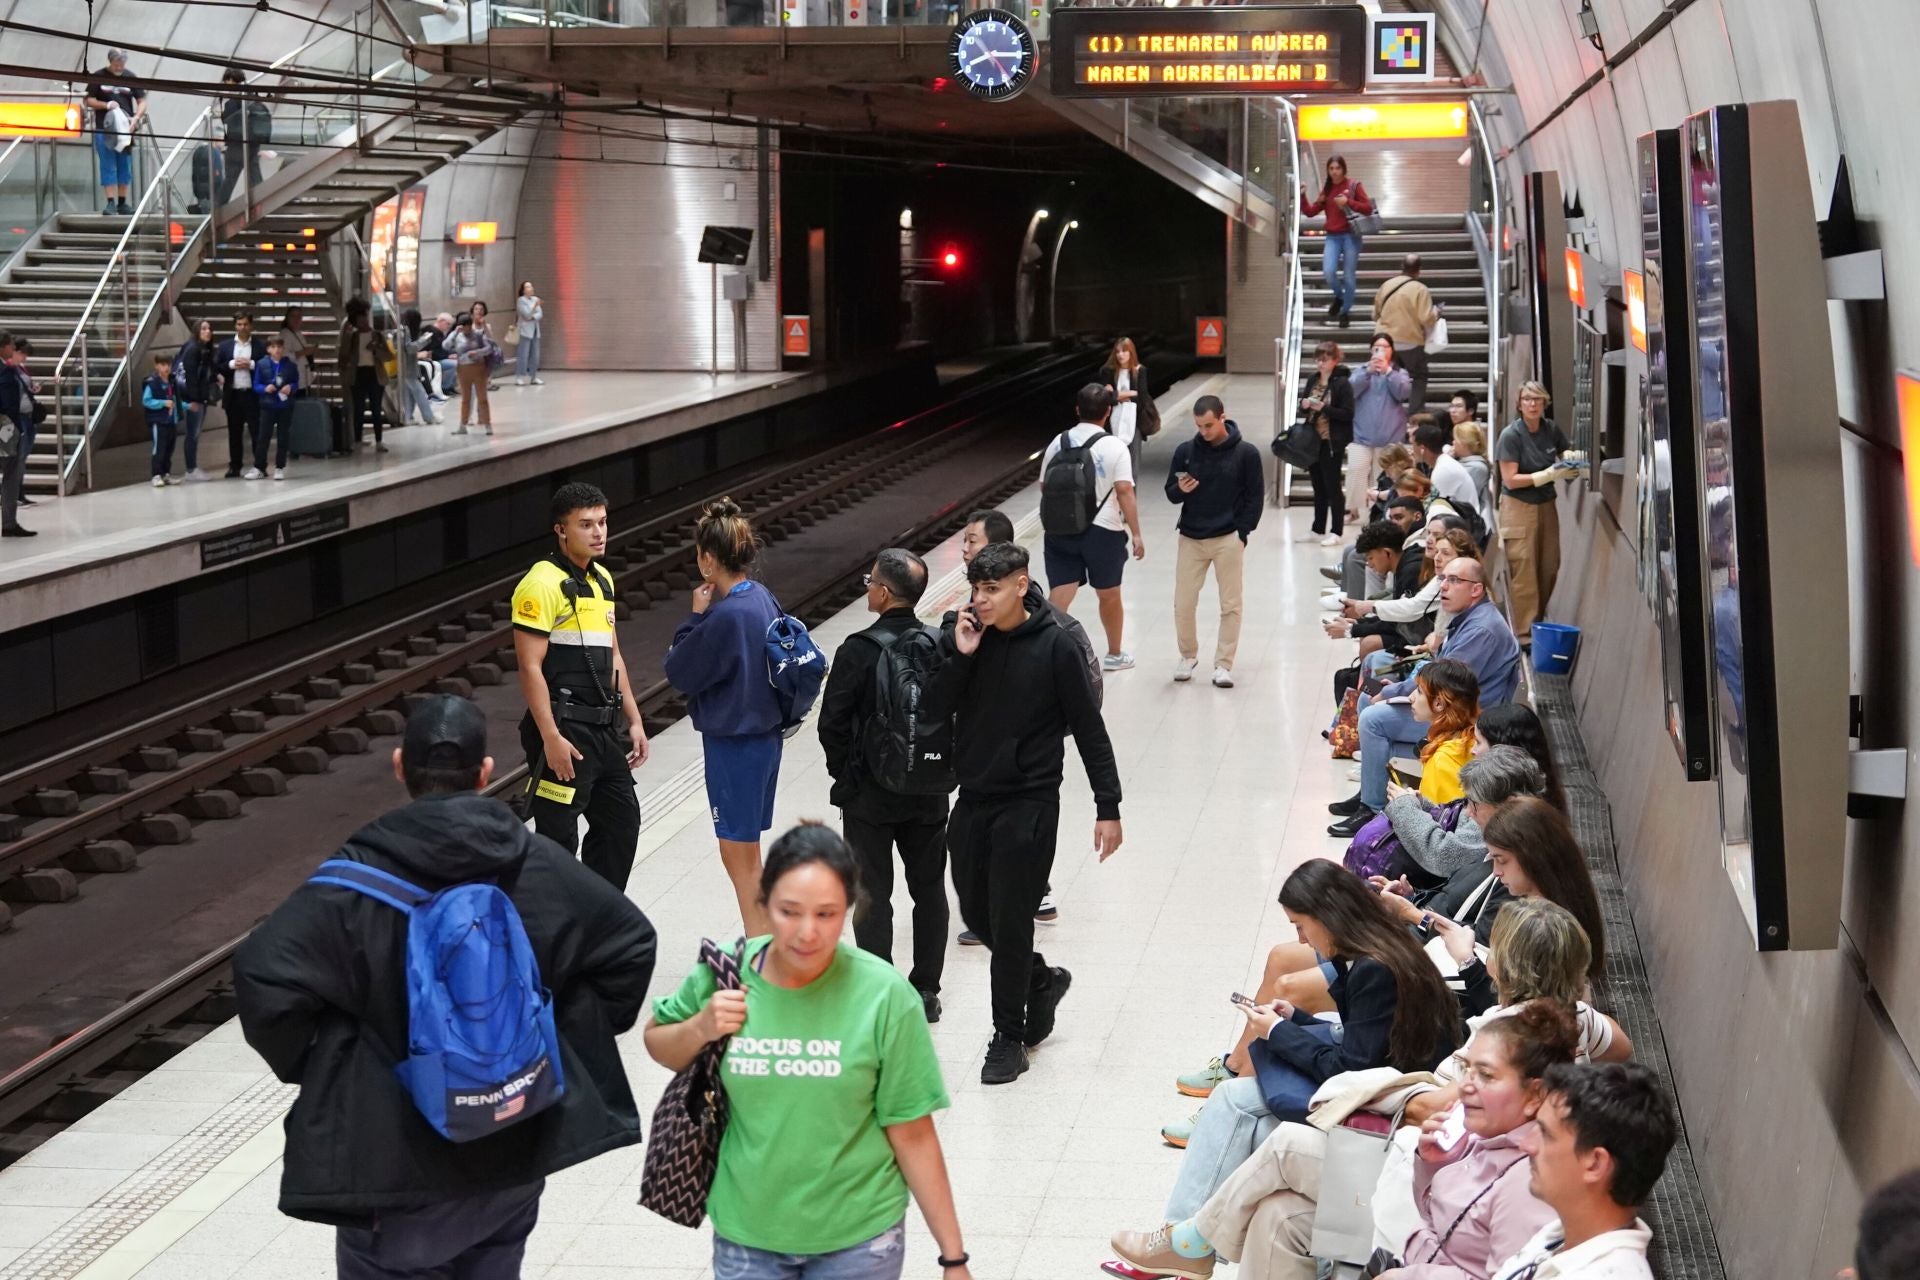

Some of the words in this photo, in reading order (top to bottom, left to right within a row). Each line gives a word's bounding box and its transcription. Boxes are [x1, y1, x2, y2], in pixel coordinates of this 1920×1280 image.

[975, 26, 982, 35] 11
[986, 23, 996, 32] 12
[1002, 26, 1006, 35] 1
[965, 36, 975, 45] 10
[1011, 36, 1018, 45] 2
[1089, 36, 1124, 53] (1)
[1138, 36, 1238, 52] TRENAREN
[1252, 35, 1327, 51] AURREA
[960, 50, 967, 59] 9
[965, 65, 972, 73] 8
[1011, 64, 1017, 73] 4
[1087, 65, 1150, 82] NAREN
[1163, 65, 1301, 81] AURREALDEAN
[1315, 64, 1327, 81] D
[975, 74, 981, 82] 7
[988, 77, 994, 86] 6
[728, 1036, 802, 1056] FOCUS
[806, 1039, 842, 1056] ON
[728, 1057, 770, 1076] THE
[775, 1059, 842, 1077] GOOD
[455, 1089, 504, 1106] PENN
